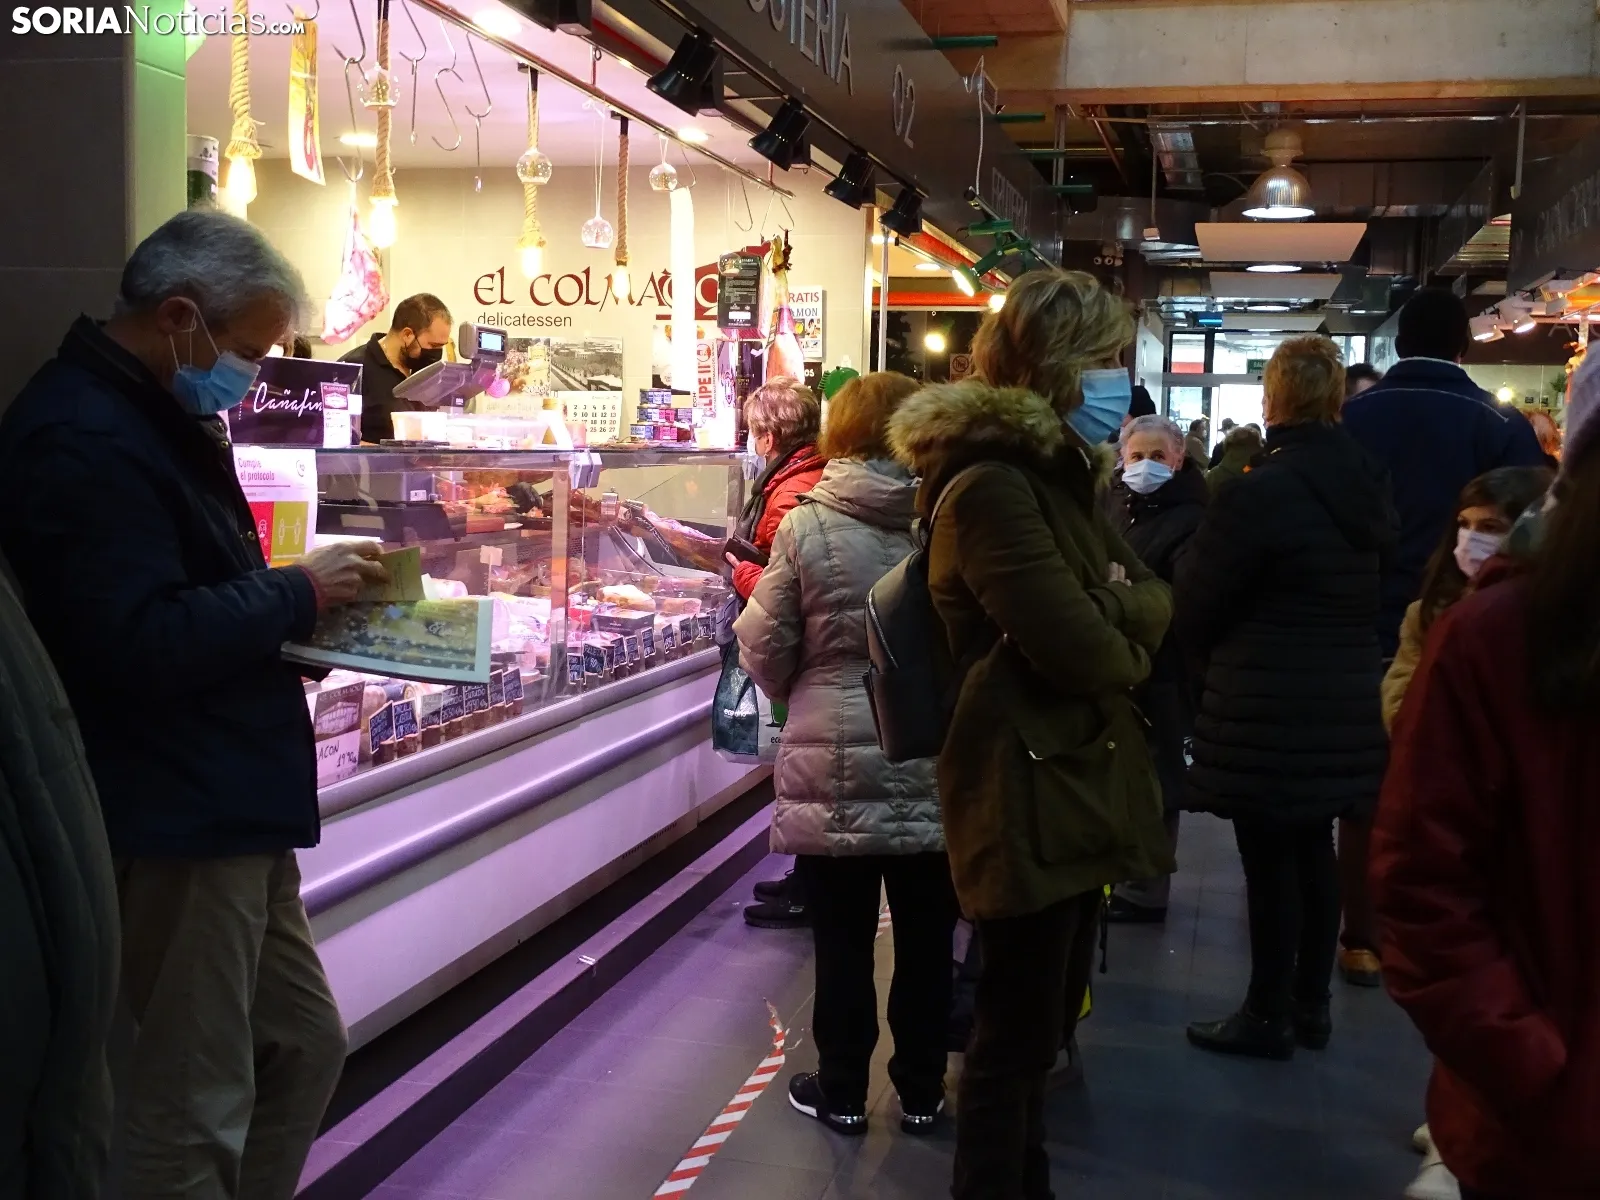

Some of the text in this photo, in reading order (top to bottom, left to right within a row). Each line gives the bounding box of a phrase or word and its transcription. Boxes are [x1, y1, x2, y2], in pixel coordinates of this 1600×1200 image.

[473, 265, 515, 306] EL
[788, 291, 820, 303] RATIS
[477, 312, 572, 327] delicatessen
[789, 307, 818, 317] AMON
[698, 377, 713, 411] LIPE
[318, 739, 340, 761] ACON
